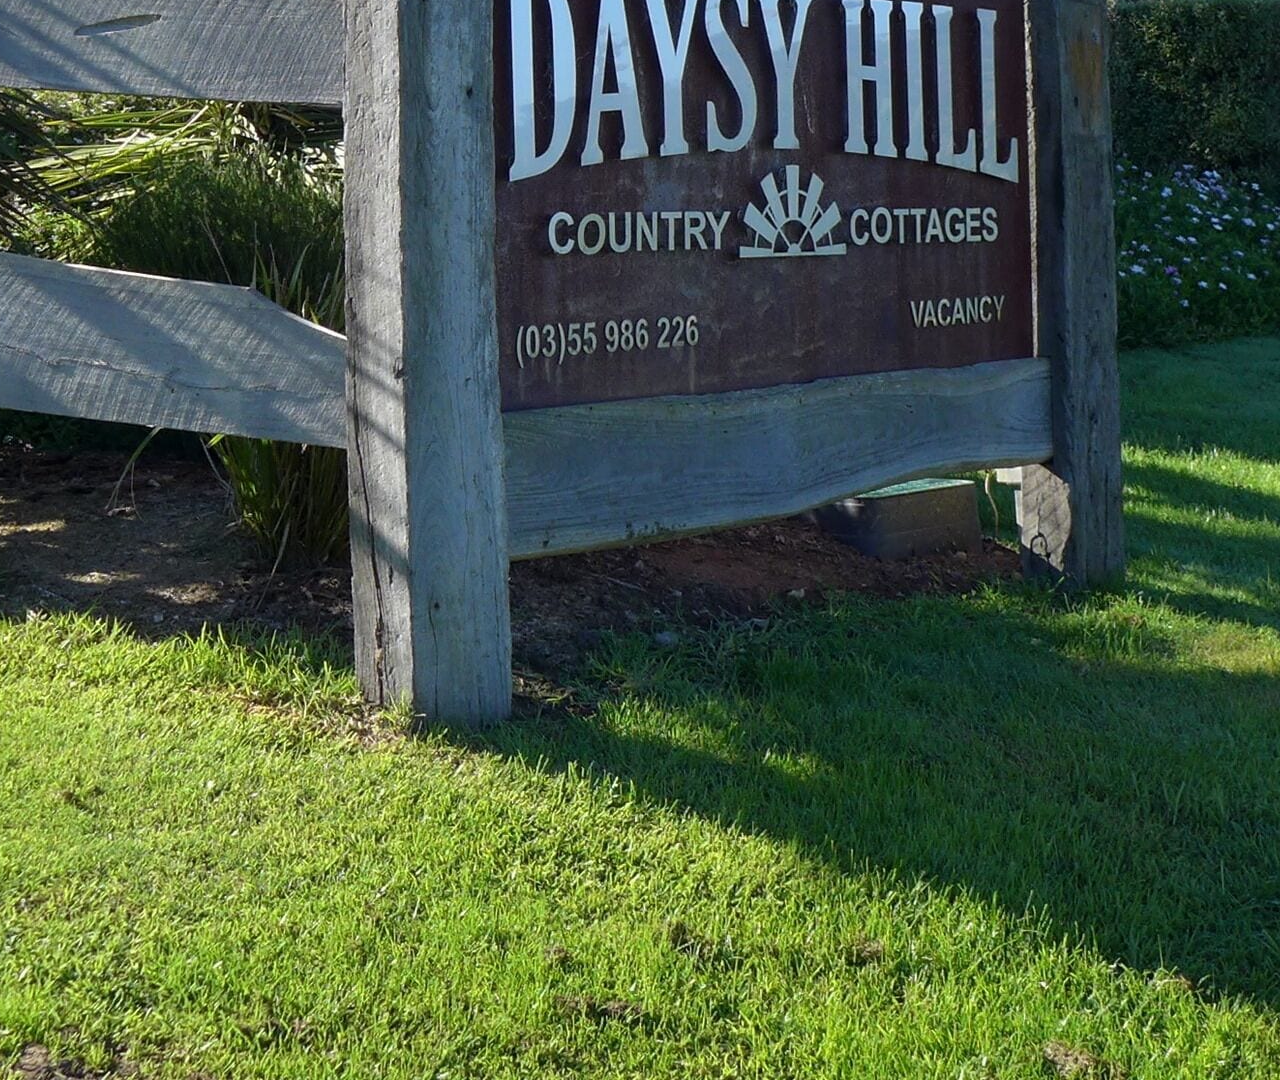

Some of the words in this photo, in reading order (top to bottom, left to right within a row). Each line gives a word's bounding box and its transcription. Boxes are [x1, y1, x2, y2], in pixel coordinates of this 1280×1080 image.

[548, 211, 730, 255] COUNTRY
[850, 207, 998, 246] COTTAGES
[910, 295, 1005, 327] VACANCY
[516, 322, 597, 368] (03)55
[605, 318, 648, 353] 986
[657, 315, 699, 348] 226
